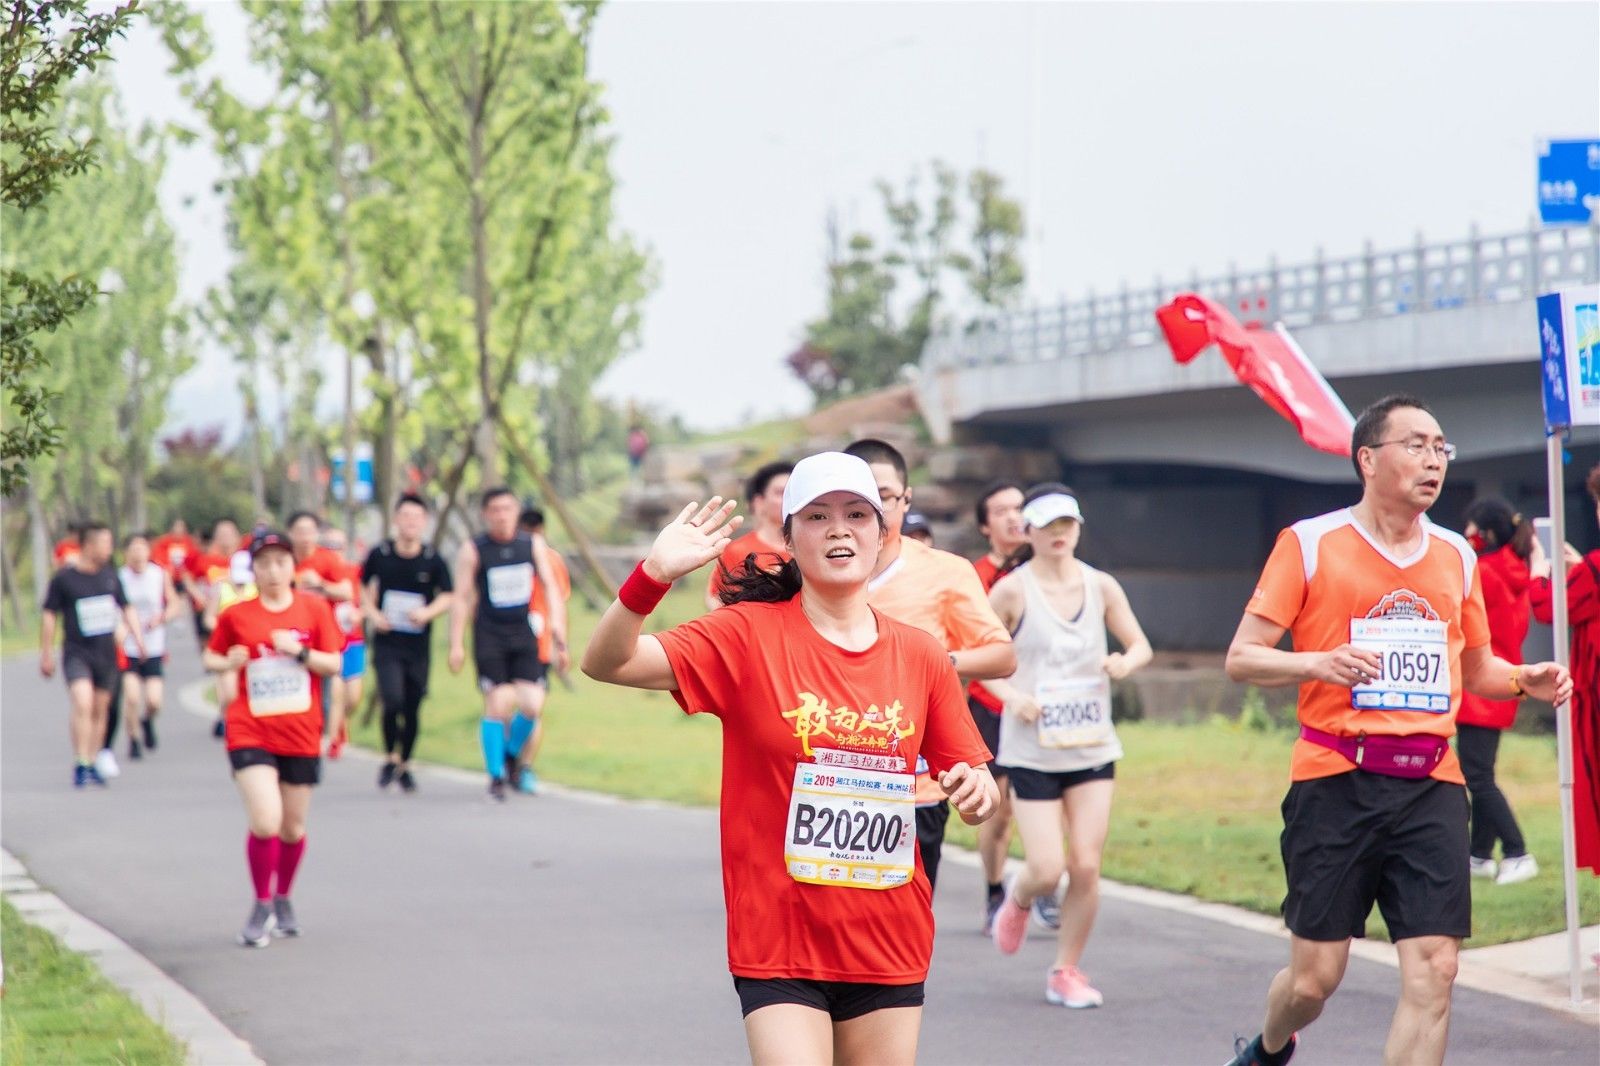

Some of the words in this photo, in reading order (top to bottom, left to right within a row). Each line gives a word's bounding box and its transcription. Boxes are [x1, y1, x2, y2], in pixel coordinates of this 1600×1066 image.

[1380, 651, 1441, 684] 10597
[1041, 702, 1101, 727] B20043
[814, 774, 835, 788] 2019
[793, 803, 903, 854] B20200
